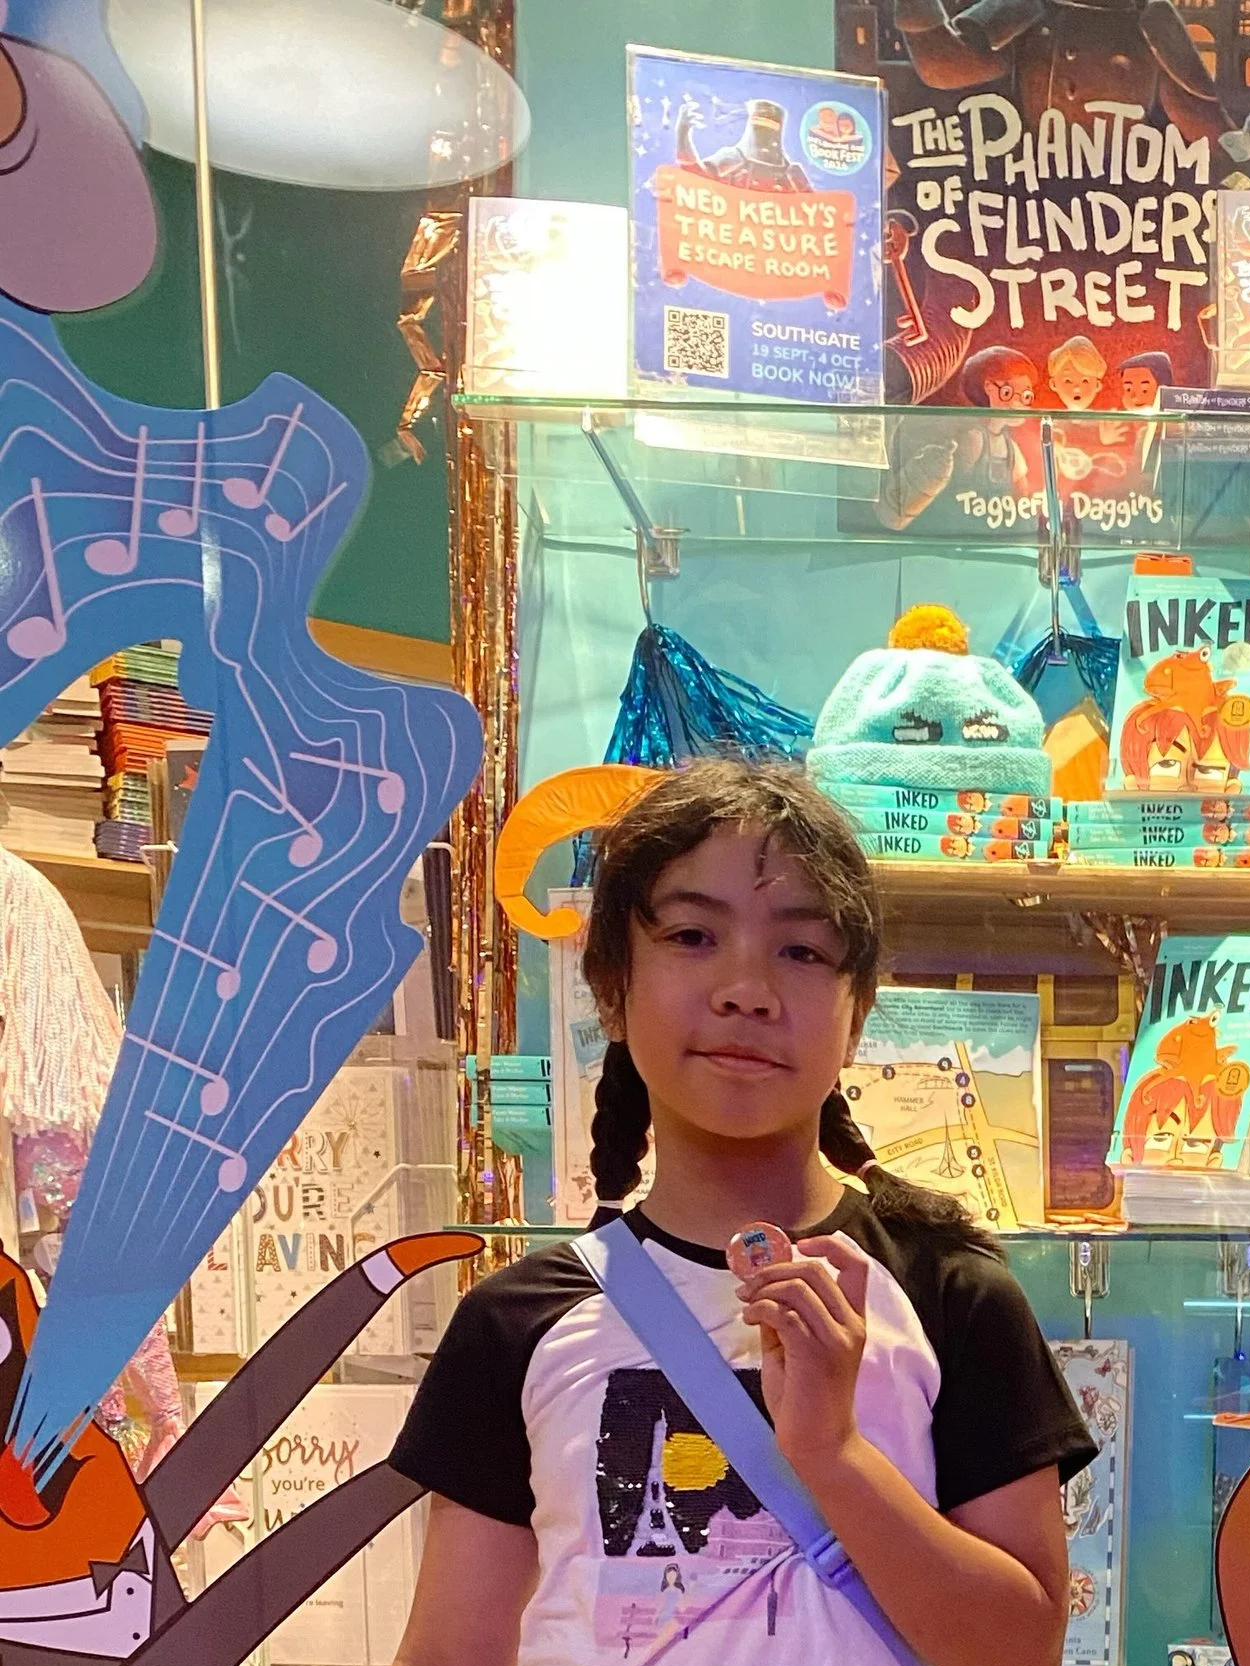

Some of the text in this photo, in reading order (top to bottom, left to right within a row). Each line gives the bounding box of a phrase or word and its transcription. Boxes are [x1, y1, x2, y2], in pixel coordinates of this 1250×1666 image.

[892, 93, 1209, 193] THE PHANTOM
[675, 184, 836, 228] NED KELLY'S
[917, 175, 963, 214] OF
[674, 214, 839, 257] TREASURE
[678, 242, 830, 280] ESCAPE ROOM
[921, 218, 1208, 331] STREET
[752, 321, 860, 350] SOUTHGATE
[753, 344, 768, 356] 19
[831, 354, 862, 368] OCT
[752, 363, 803, 383] BOOK
[956, 490, 1163, 531] Taggert Daggins
[896, 791, 939, 809] INKED
[885, 812, 928, 831] INKED
[878, 835, 921, 854] INKED
[1143, 826, 1184, 845] INKED
[1134, 850, 1175, 867] INKED
[278, 1131, 348, 1173] RRY
[887, 1145, 903, 1156] CITY
[272, 1477, 325, 1495] you're
